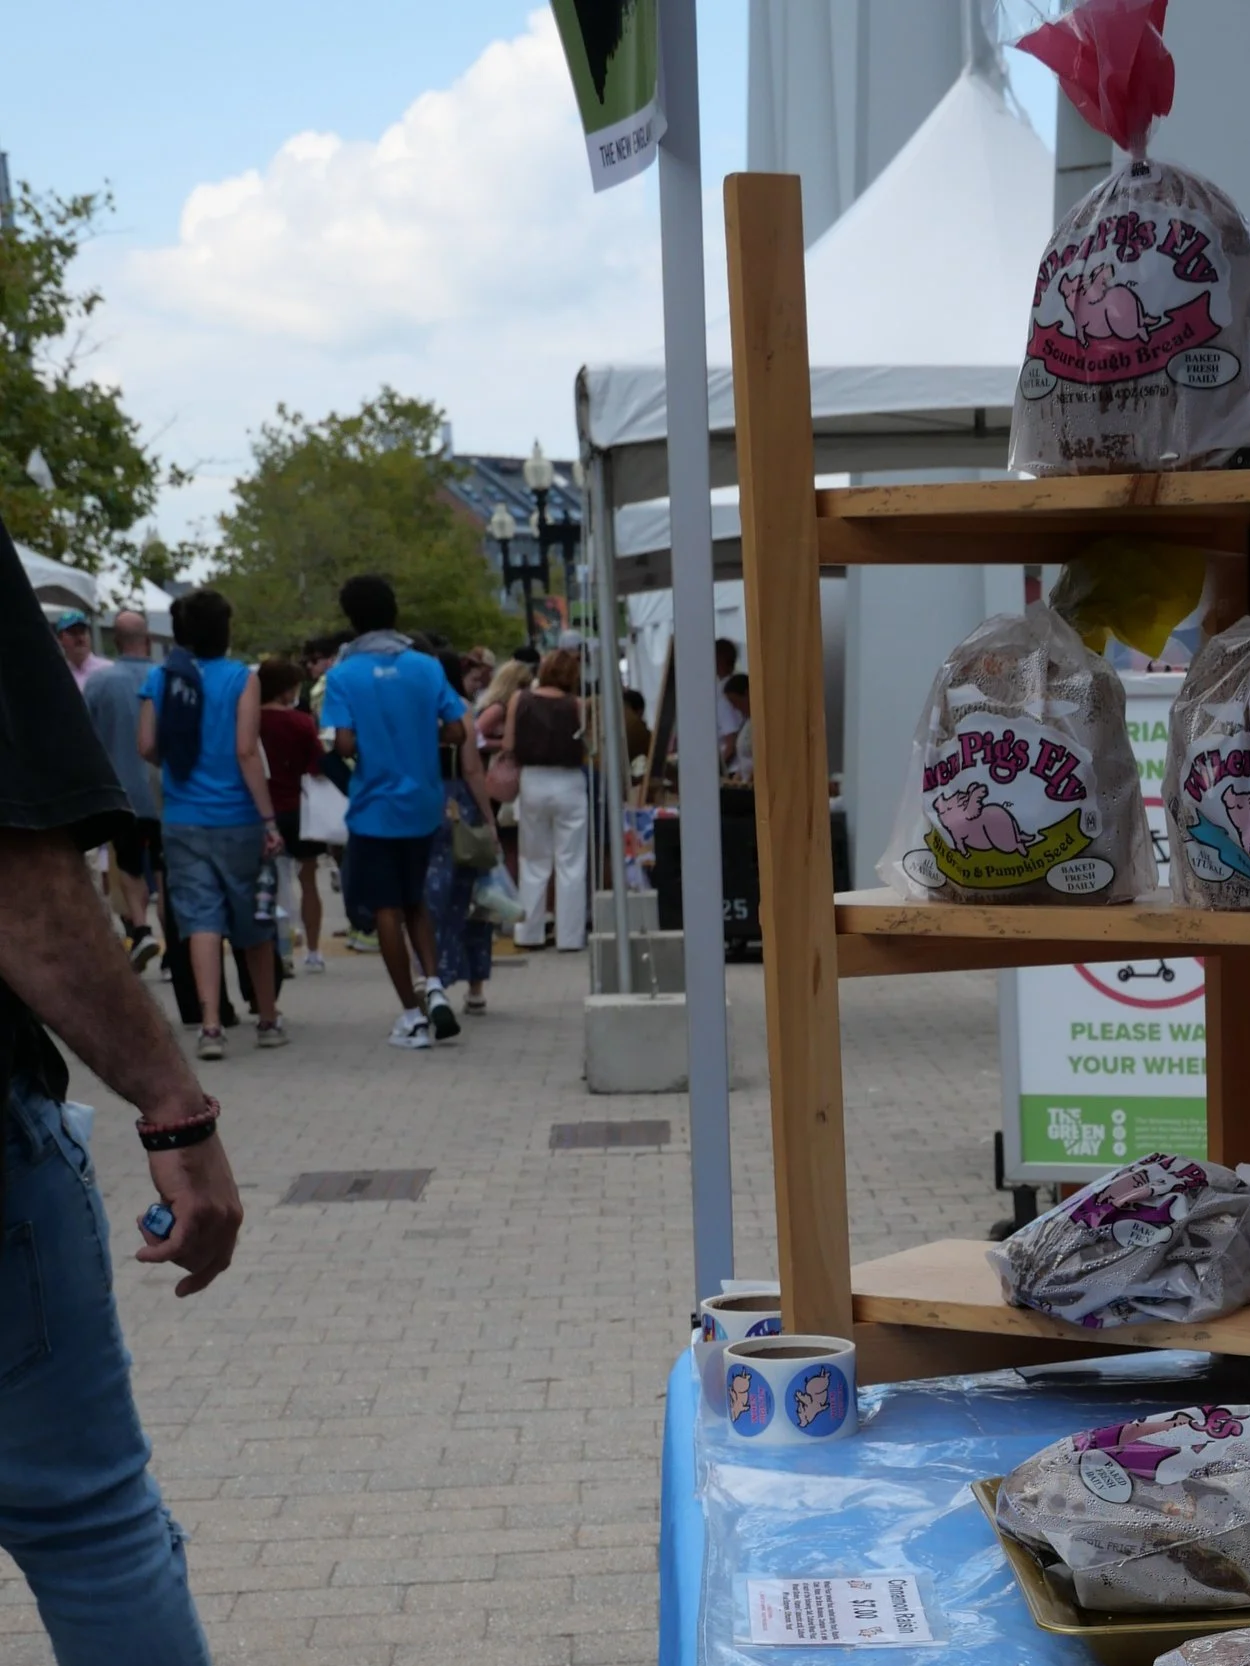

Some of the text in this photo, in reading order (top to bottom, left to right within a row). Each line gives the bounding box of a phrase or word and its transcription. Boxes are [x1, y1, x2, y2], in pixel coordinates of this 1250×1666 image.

[600, 136, 632, 167] THE NEW
[1156, 218, 1219, 283] Fly
[1042, 322, 1195, 373] Sourdough Bread
[1185, 352, 1221, 363] BAKED
[1186, 363, 1220, 374] FRESH
[1188, 373, 1219, 384] DAILY
[958, 730, 1087, 802] Pigs Fly
[973, 868, 984, 879] &
[985, 859, 1046, 881] Pumpkin
[1046, 832, 1076, 863] Seed
[1061, 862, 1096, 874] BAKED
[1064, 872, 1096, 883] FRESH
[1066, 881, 1096, 891] DAILY
[1071, 1022, 1206, 1042] PLEASE WA
[1068, 1056, 1207, 1075] YOUR WHE
[1047, 1107, 1082, 1125] THE
[1047, 1123, 1105, 1141] GREEN
[1065, 1140, 1101, 1156] WAY
[1096, 1468, 1116, 1489] FRESH
[1104, 1460, 1127, 1487] BAKED
[850, 1599, 879, 1619] $7.00
[888, 1579, 918, 1634] Cinnamon Raisin
